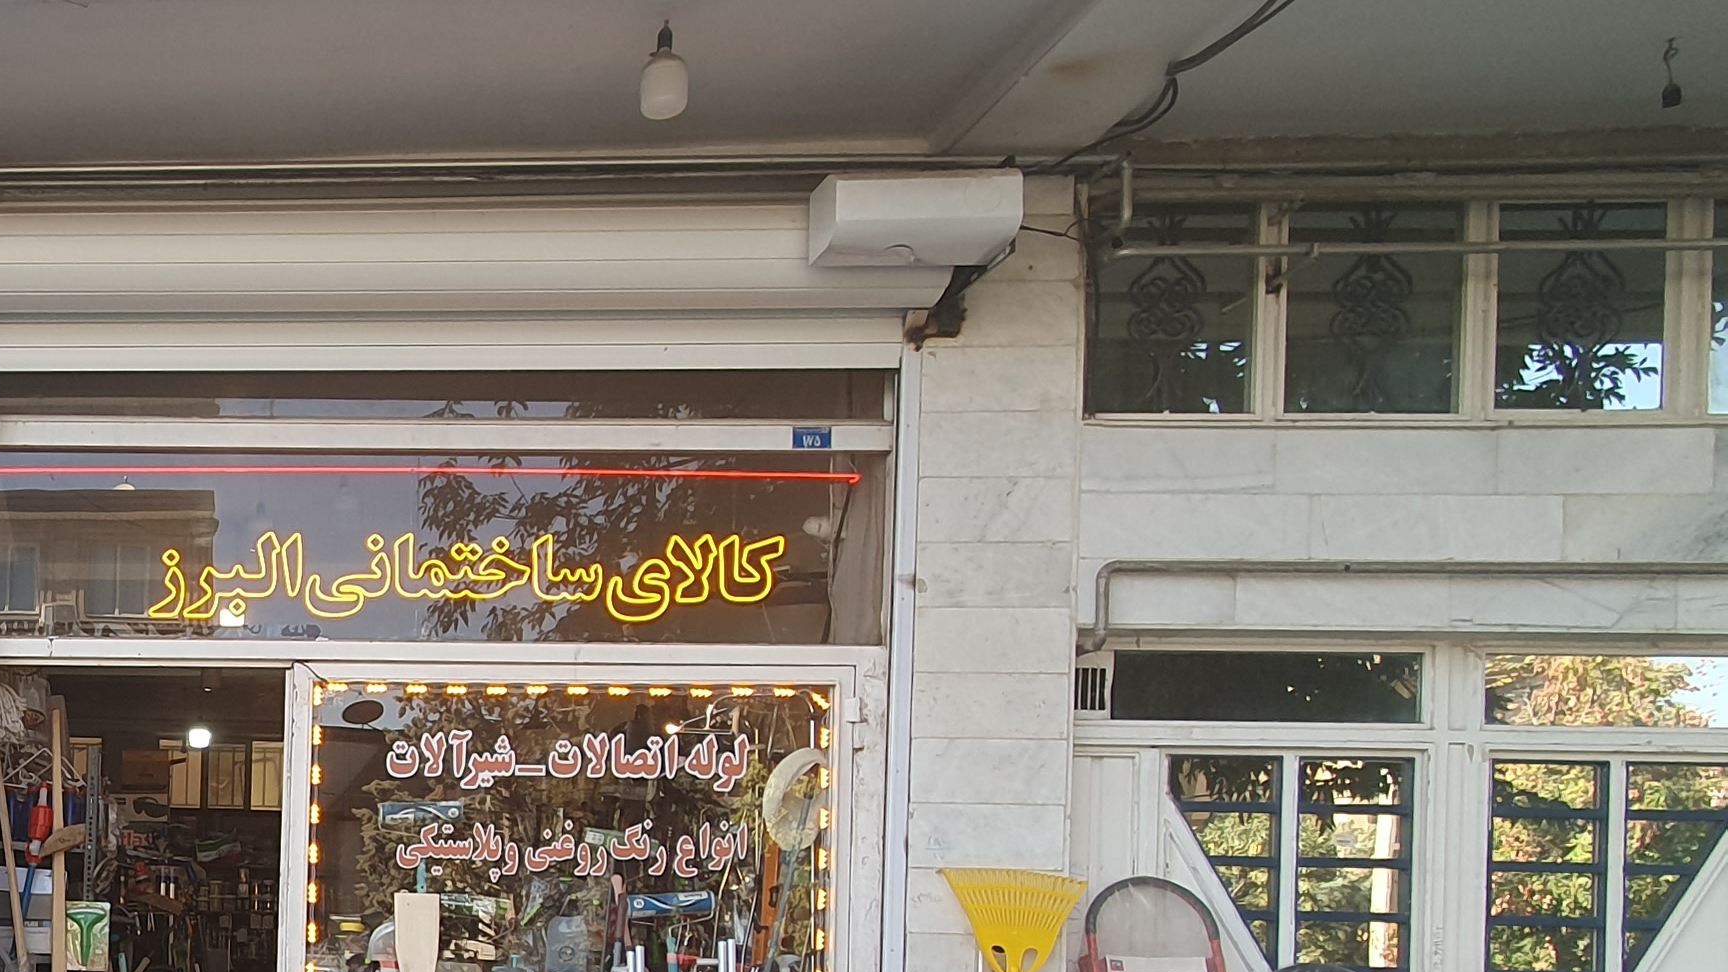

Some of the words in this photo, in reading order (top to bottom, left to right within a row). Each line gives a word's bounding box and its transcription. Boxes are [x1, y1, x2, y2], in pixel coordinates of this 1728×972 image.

[148, 531, 303, 618] البرز
[305, 533, 603, 618] ساختمانی
[606, 534, 785, 622] کالای
[549, 732, 678, 780] اتصالات
[685, 734, 750, 792] لوله
[525, 819, 607, 876] روغنی
[610, 818, 667, 876] رنگ
[674, 822, 748, 877] انواع
